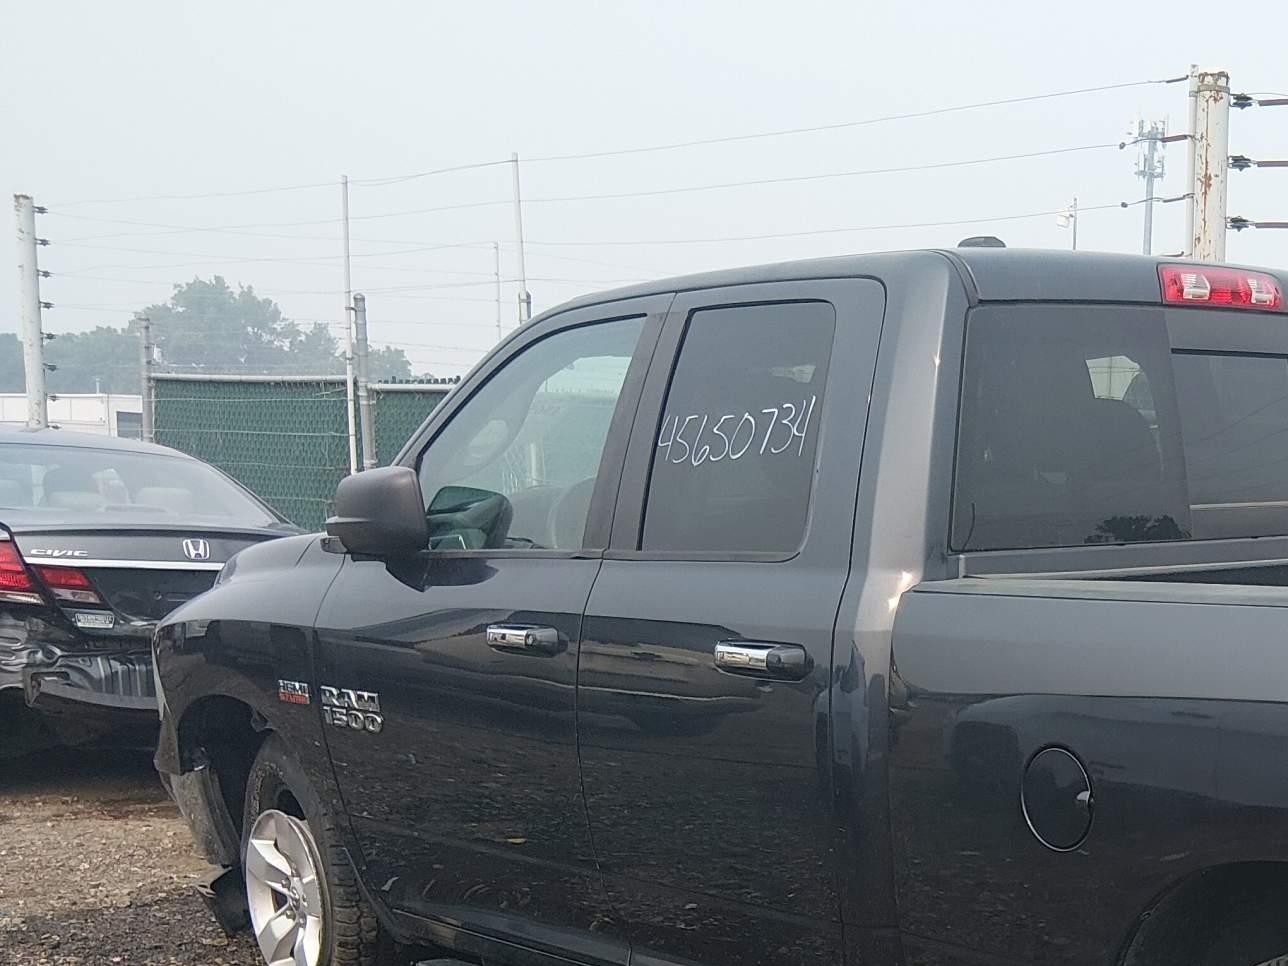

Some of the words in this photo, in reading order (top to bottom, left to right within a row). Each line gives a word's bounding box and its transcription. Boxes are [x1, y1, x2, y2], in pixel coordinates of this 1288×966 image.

[658, 395, 817, 467] 45650734
[320, 685, 381, 712] RAM
[322, 706, 385, 734] 1500
